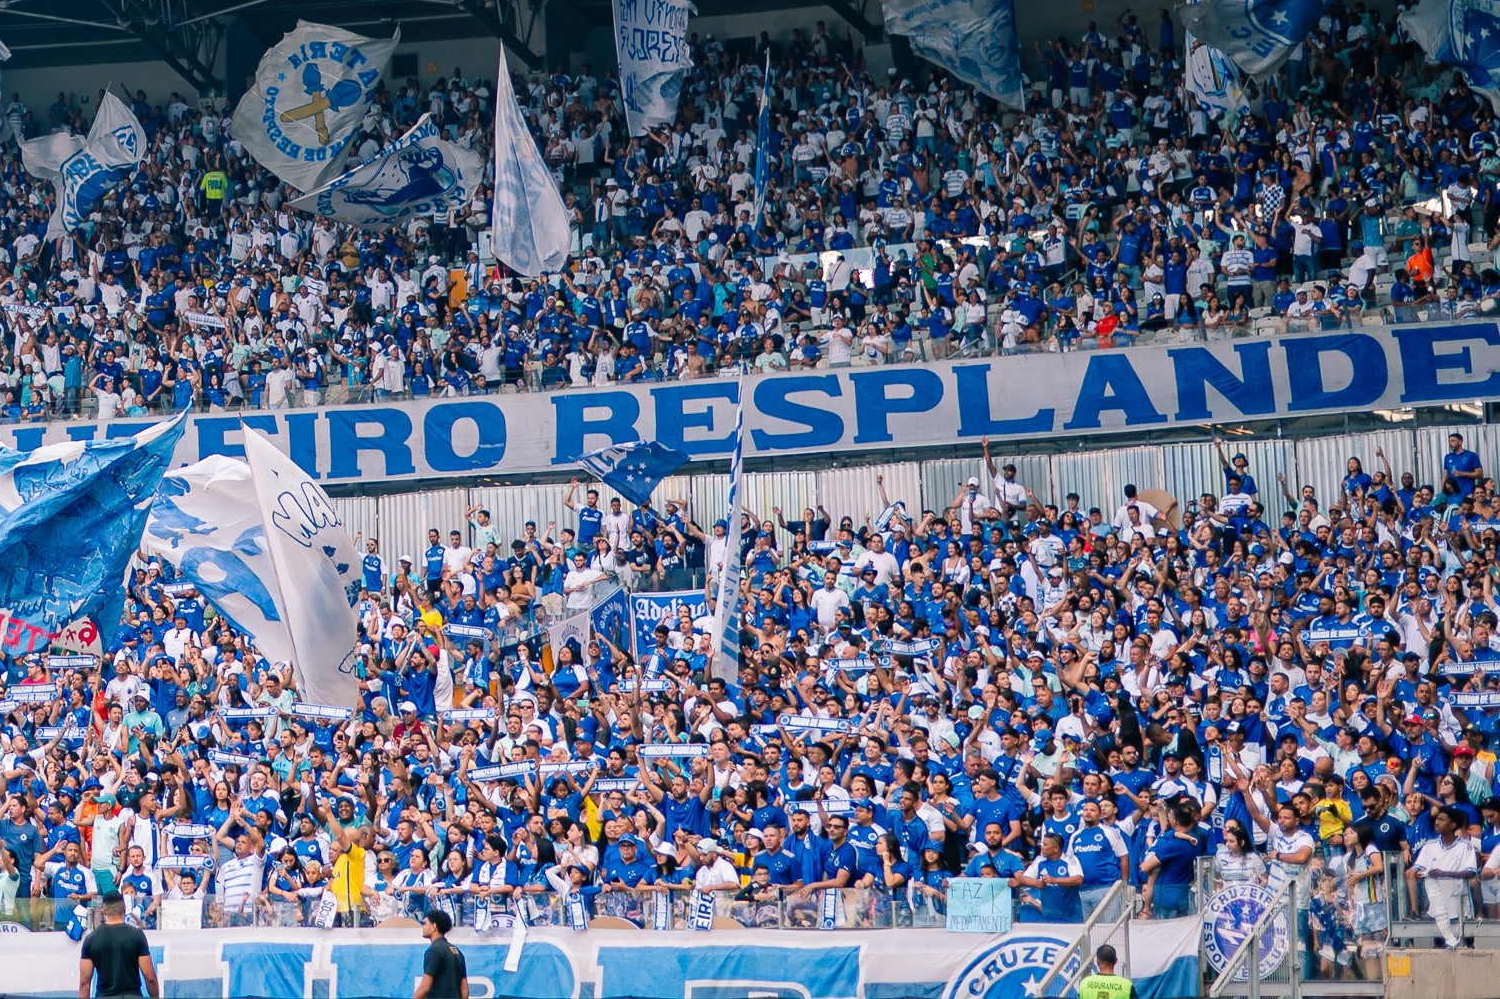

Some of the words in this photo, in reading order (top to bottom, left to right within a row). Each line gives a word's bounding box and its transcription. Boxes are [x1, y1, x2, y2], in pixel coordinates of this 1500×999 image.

[951, 882, 983, 899] FAZ
[1211, 887, 1273, 913] CRUZEIR
[1087, 982, 1123, 991] SEGURANÇA
